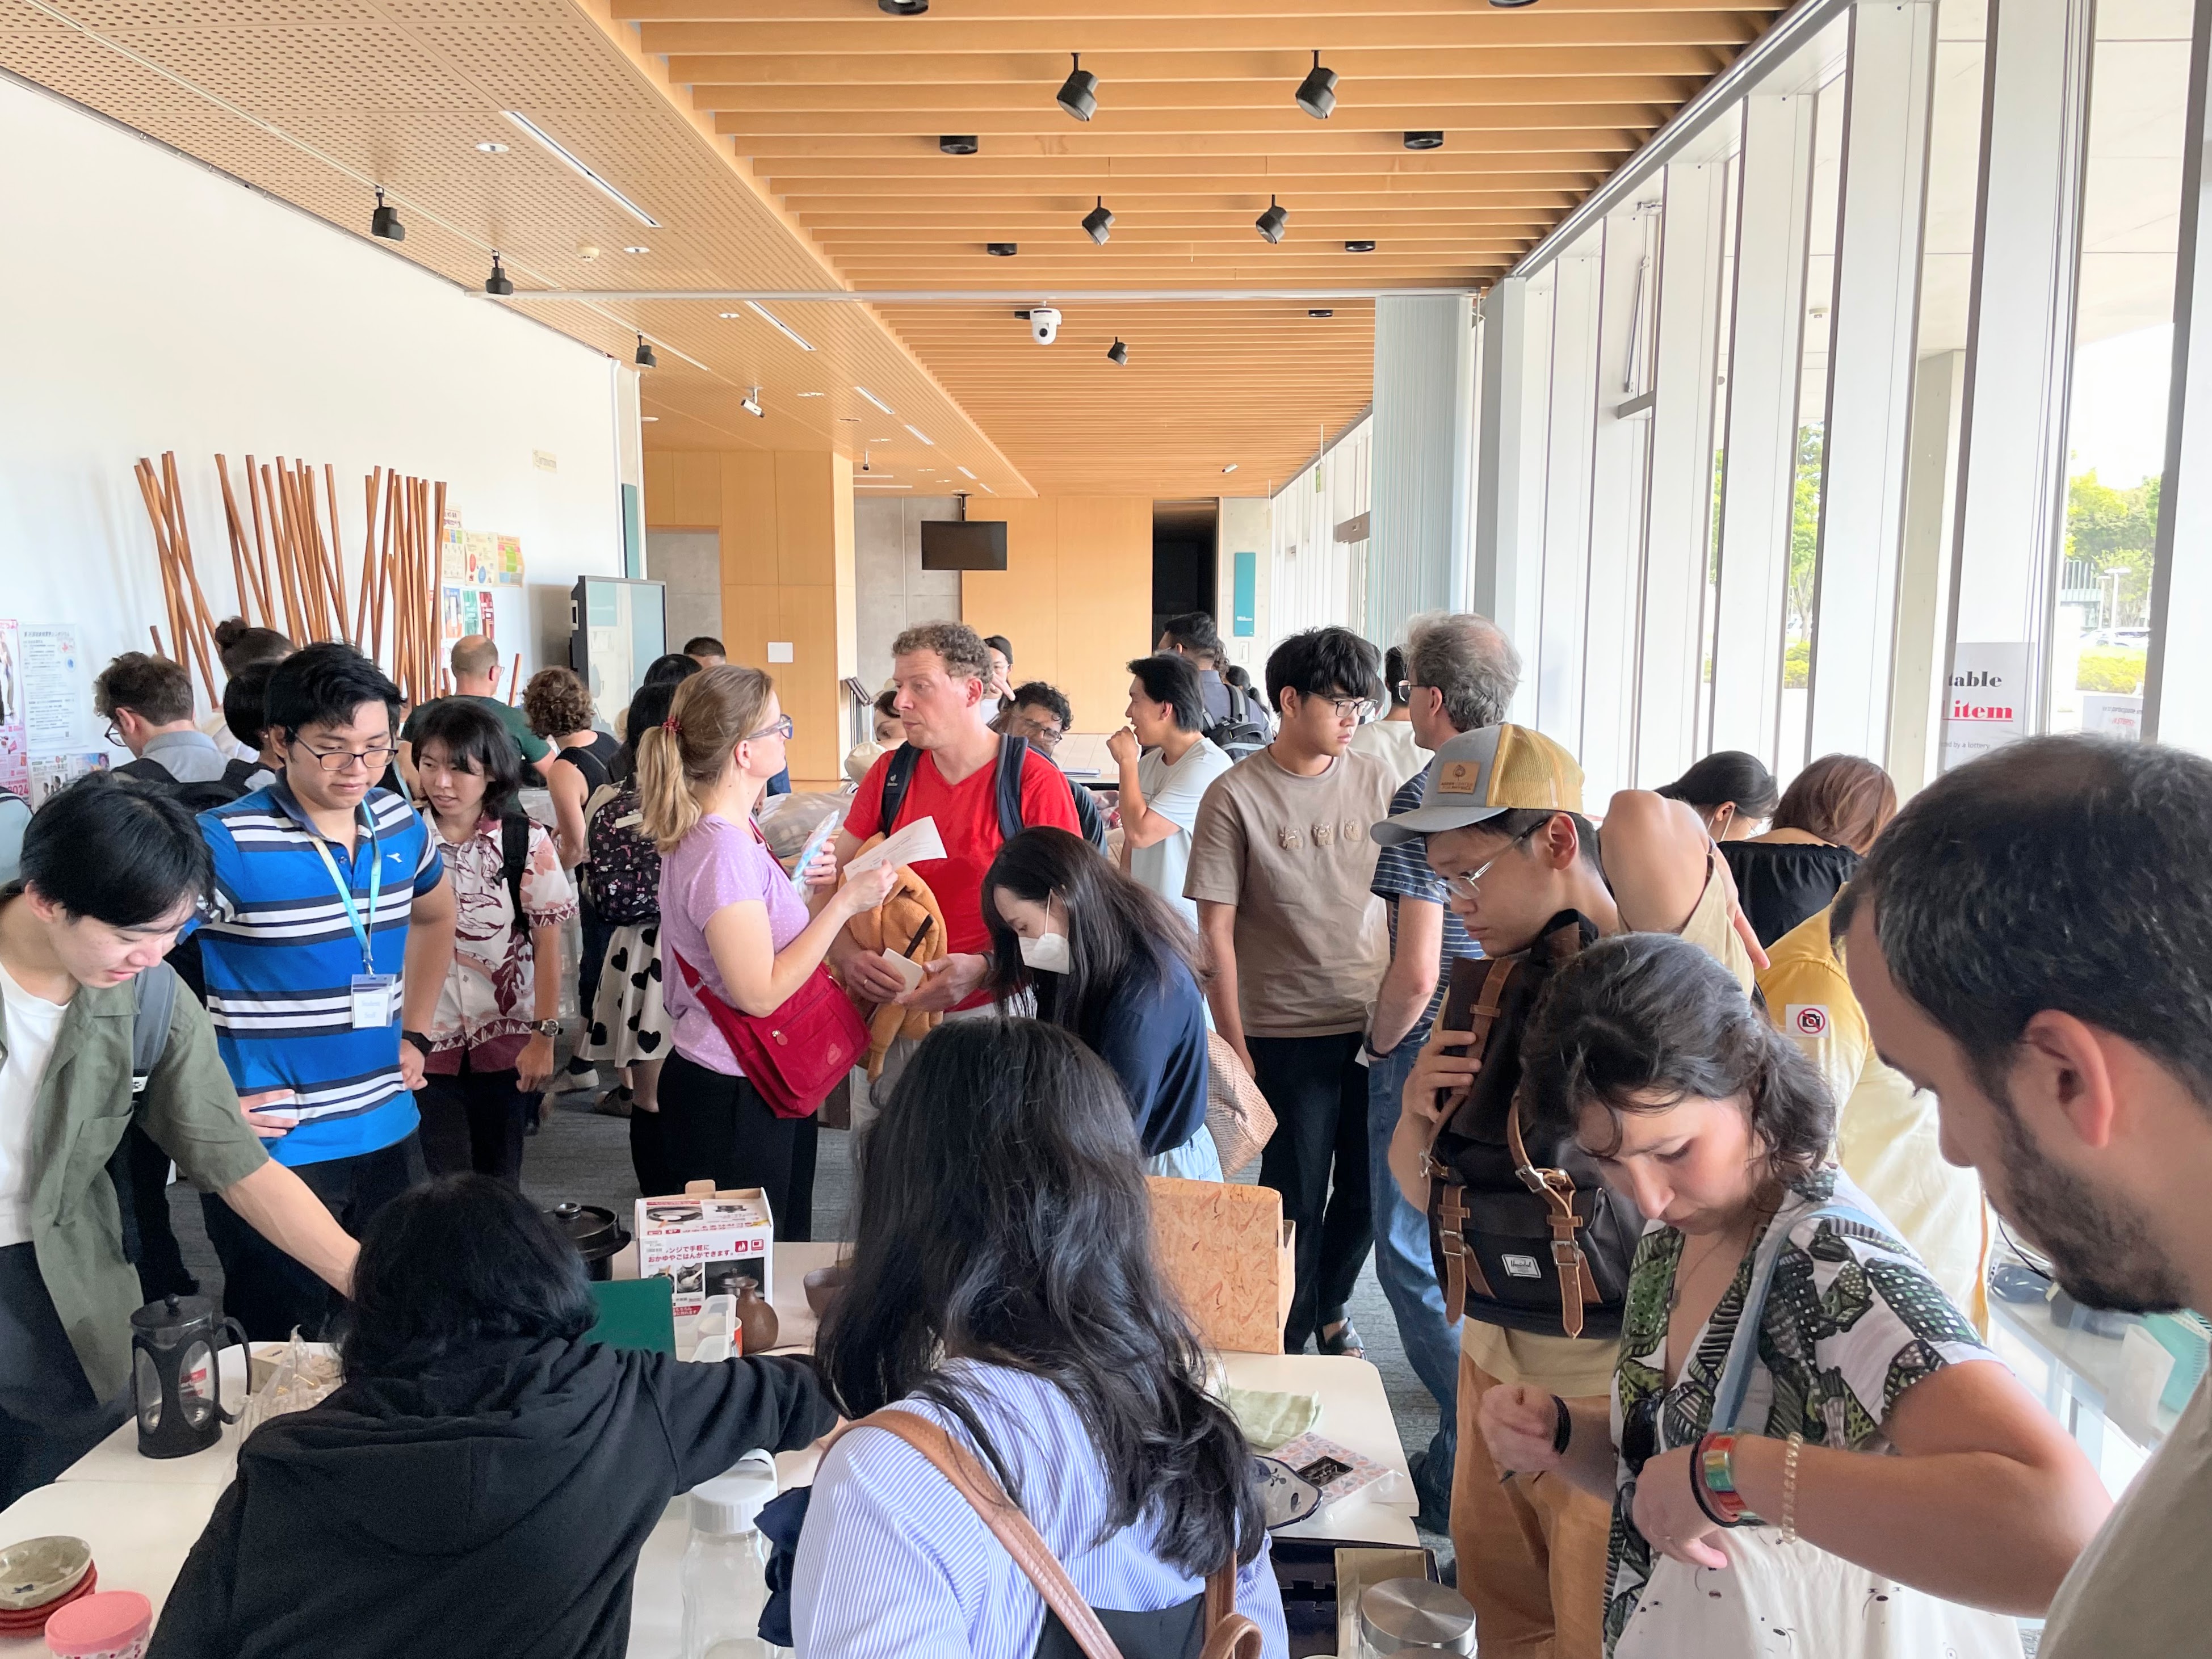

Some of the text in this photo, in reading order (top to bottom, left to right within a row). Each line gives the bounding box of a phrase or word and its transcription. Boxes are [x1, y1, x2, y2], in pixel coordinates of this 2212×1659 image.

[1948, 671, 2002, 687] table
[1953, 700, 2013, 719] item
[666, 1245, 710, 1254] ンジで手軽に
